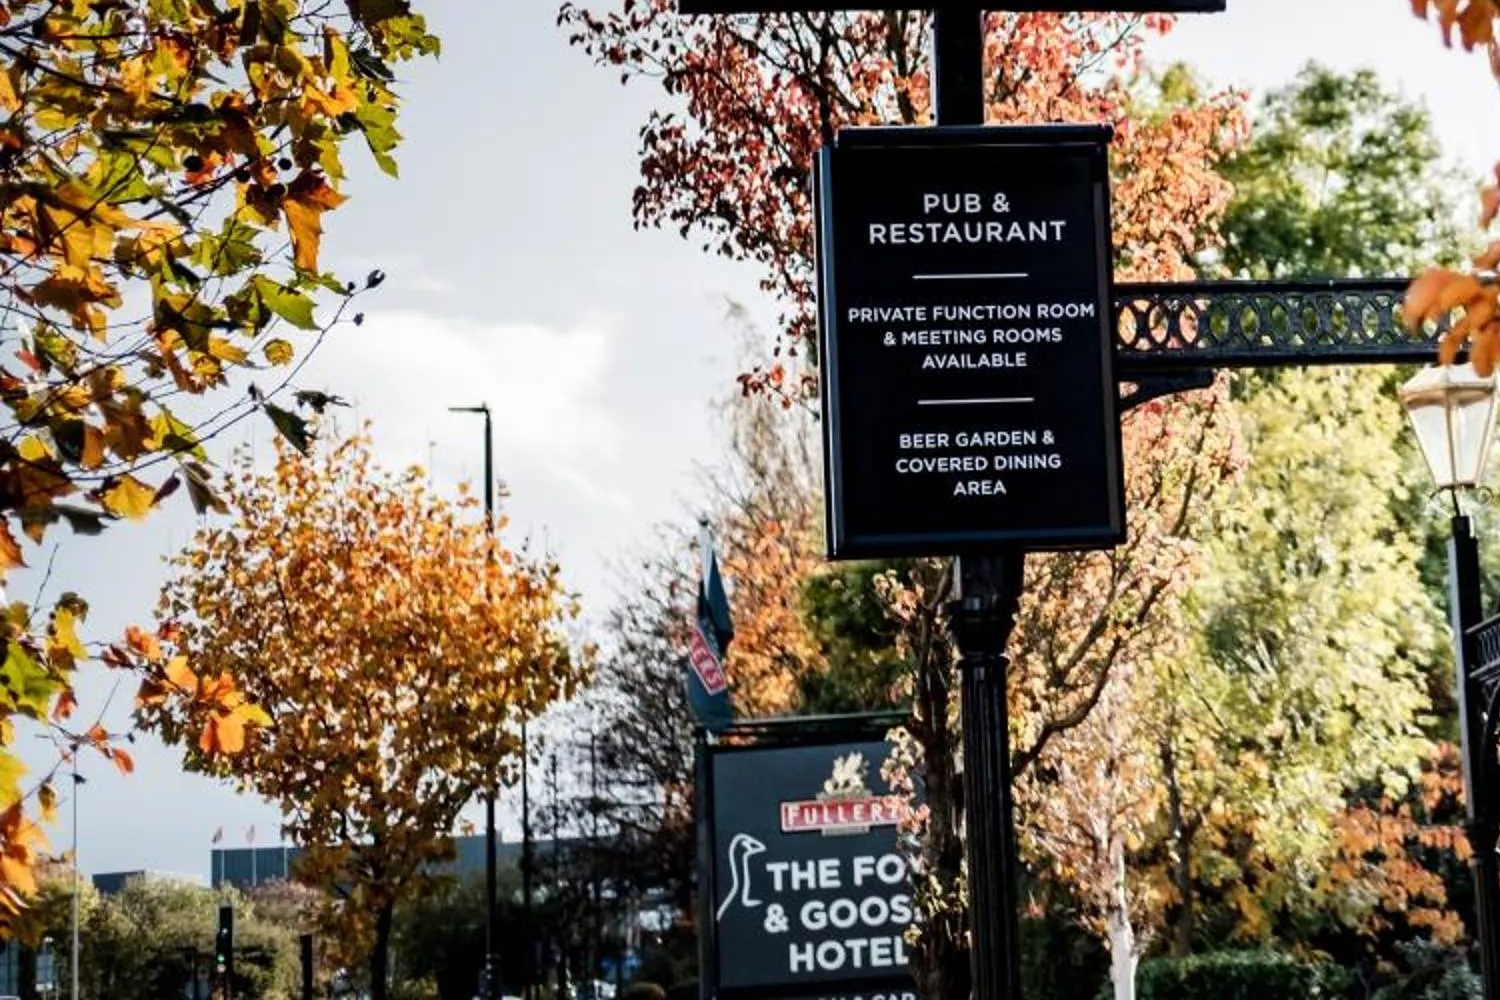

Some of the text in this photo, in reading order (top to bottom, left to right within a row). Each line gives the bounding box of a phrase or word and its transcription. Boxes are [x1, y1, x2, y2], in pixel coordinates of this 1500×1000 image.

[923, 192, 1011, 214] PUB &
[869, 220, 1067, 245] RESTAURANT
[848, 303, 1096, 323] PRIVATE FUNCTION ROOM
[883, 327, 1063, 346] & MEETING ROOMS
[922, 352, 1028, 369] AVAILABLE
[899, 429, 1056, 449] BEER GARDEN &
[895, 453, 1062, 474] COVERED DINING
[953, 479, 1007, 496] AREA
[765, 853, 911, 892] THE FO
[763, 894, 922, 933] & GOOS
[789, 935, 909, 973] HOTEL
